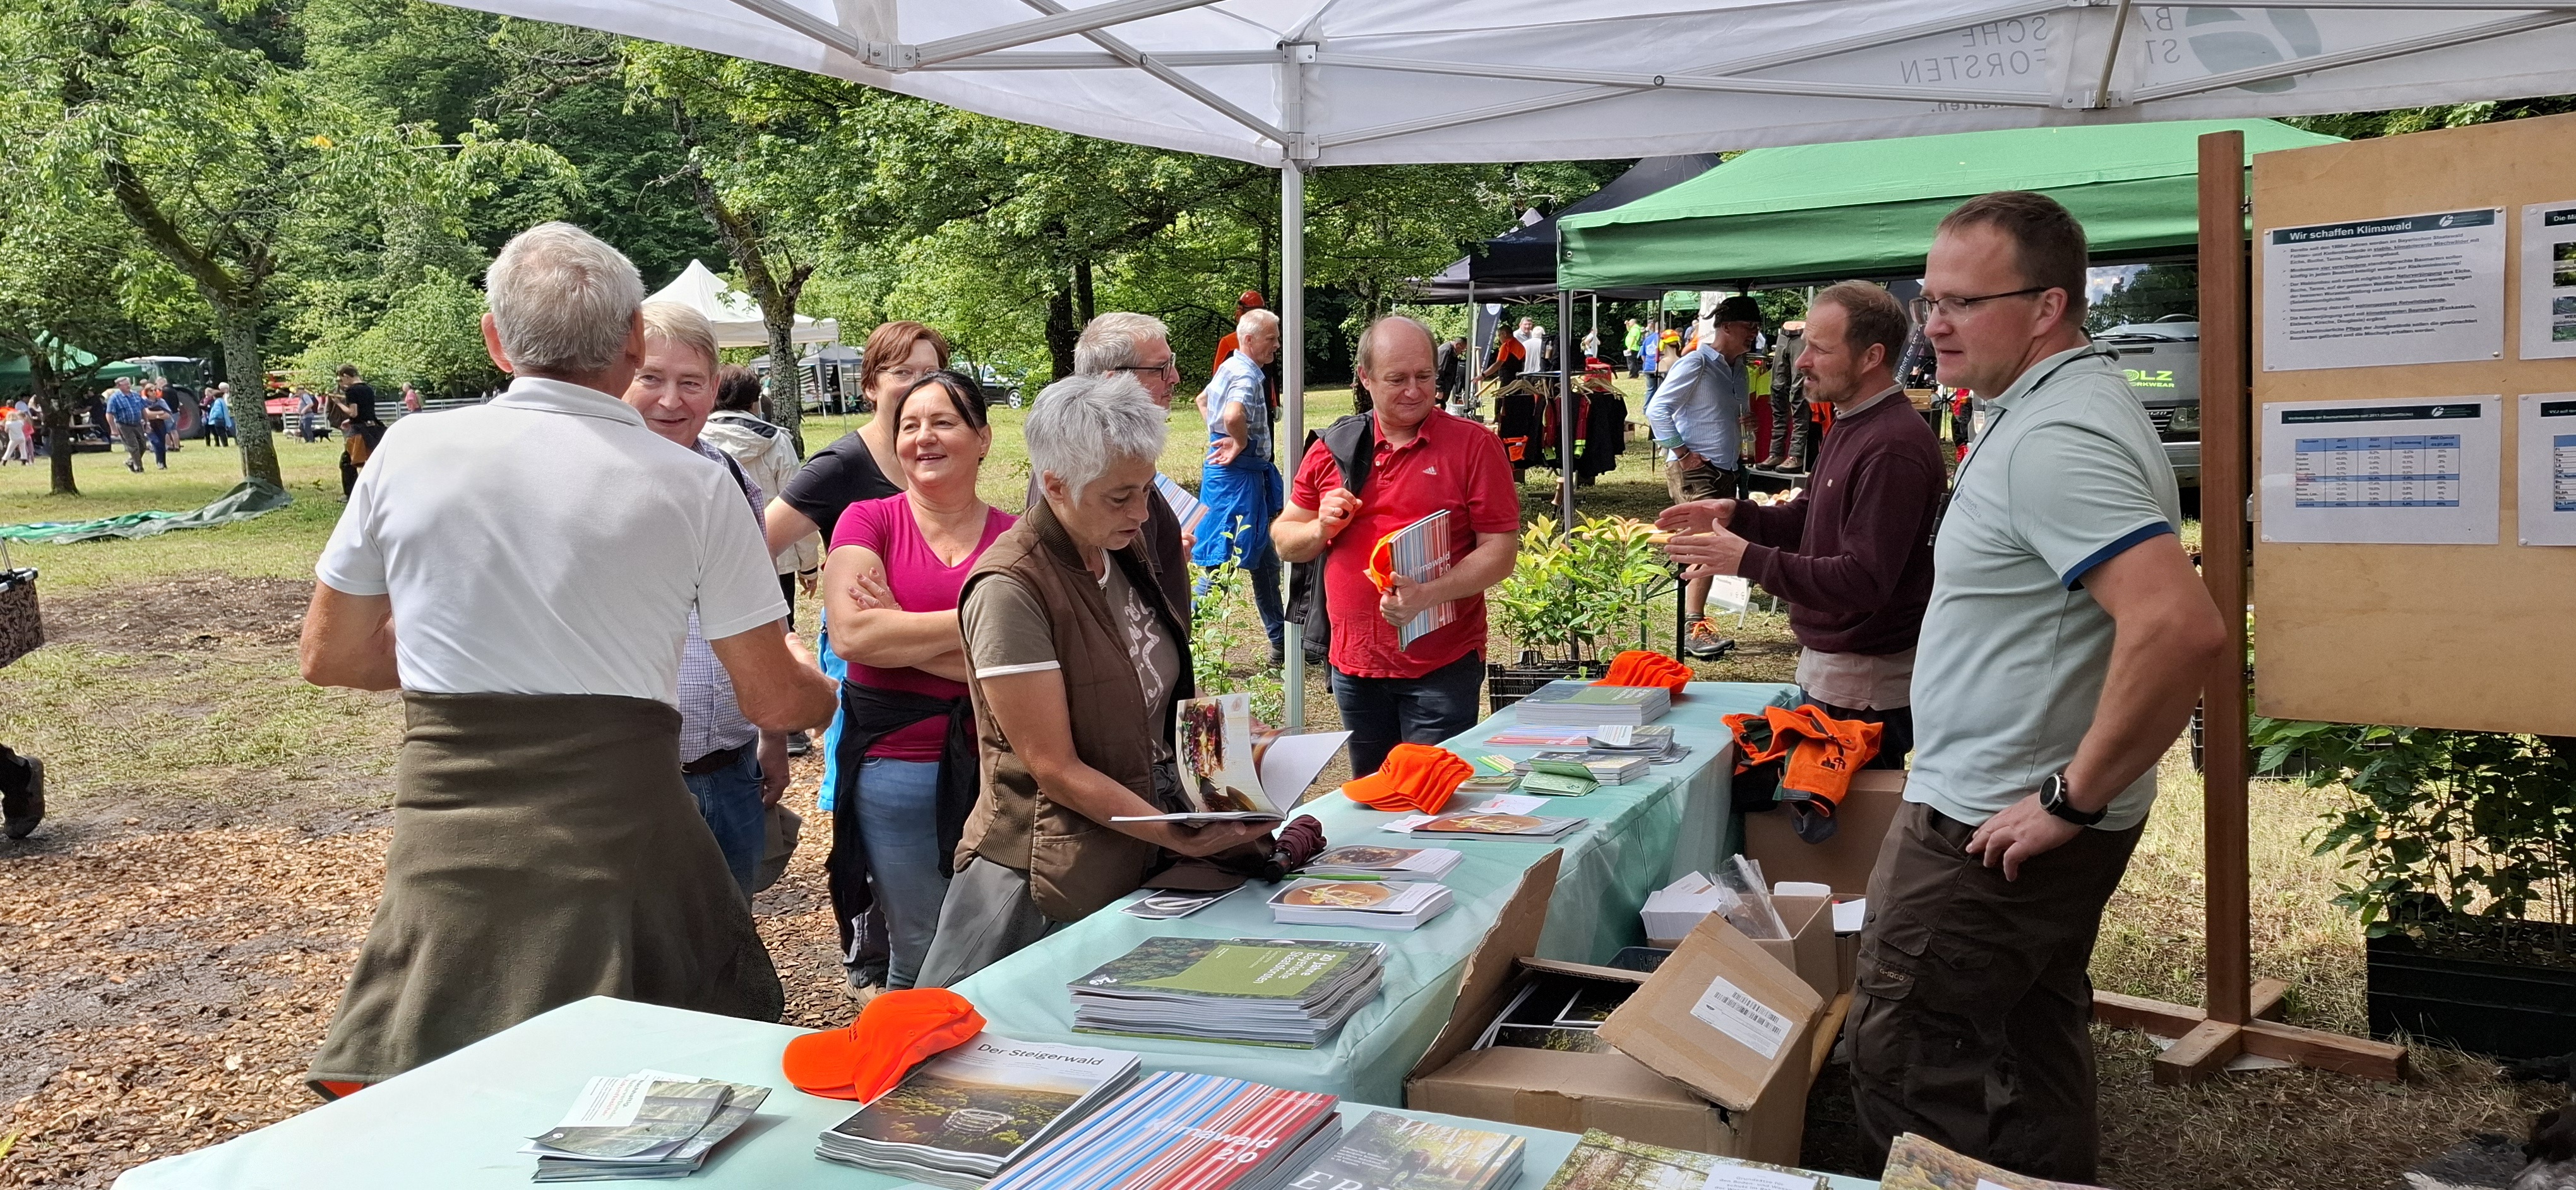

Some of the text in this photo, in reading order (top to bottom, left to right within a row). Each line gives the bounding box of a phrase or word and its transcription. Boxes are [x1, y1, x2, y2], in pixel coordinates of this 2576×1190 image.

[2310, 228, 2354, 239] schaffen
[2357, 221, 2412, 234] Klimawald
[1253, 951, 1303, 984] Staatsforsten
[1279, 953, 1320, 980] Bayerische
[1301, 961, 1327, 977] Jahre
[977, 1043, 1105, 1066] Der Steigerwald
[1145, 1118, 1279, 1149] Klimawald
[1212, 1146, 1258, 1164] 2.0
